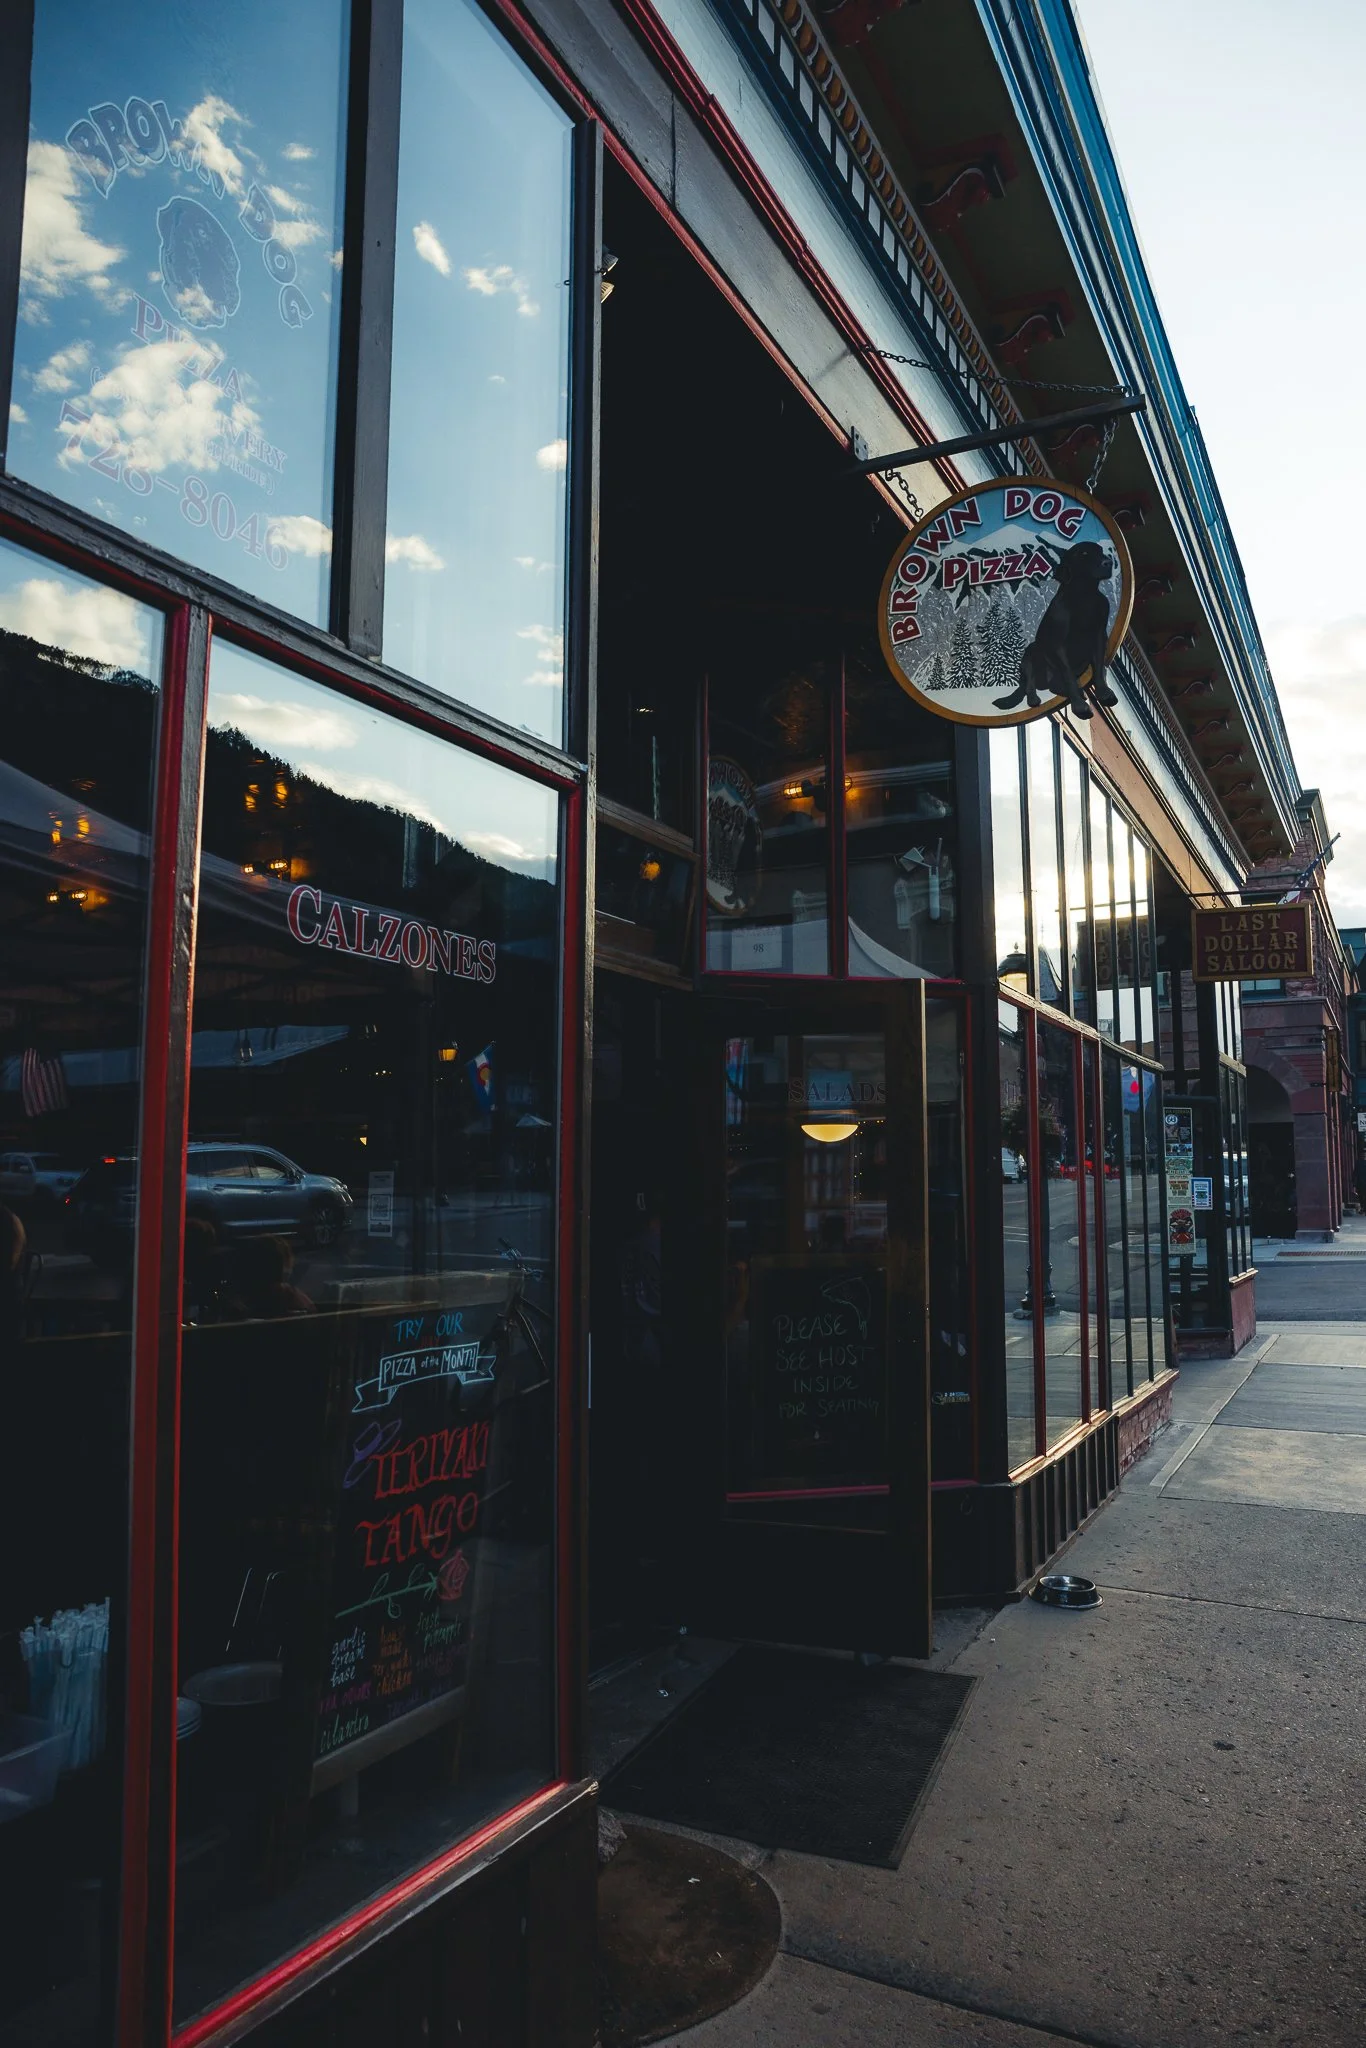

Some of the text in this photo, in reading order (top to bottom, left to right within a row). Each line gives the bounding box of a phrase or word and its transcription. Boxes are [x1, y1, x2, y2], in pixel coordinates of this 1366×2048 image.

[238, 183, 314, 329] DOG
[890, 487, 1087, 645] BROWN DOG
[942, 551, 1053, 590] PIZZA
[287, 884, 497, 984] CALZONES
[1219, 912, 1281, 932] LAST
[1203, 931, 1298, 953] DOLLAR
[1207, 952, 1296, 973] SALOON
[393, 1316, 425, 1343] TRY
[436, 1311, 464, 1337] OUR
[772, 1313, 848, 1344] PLEASE
[383, 1356, 417, 1384] PIZZA
[440, 1347, 477, 1374] MONTH
[775, 1343, 876, 1372] SEE HOST
[793, 1375, 860, 1394] INSIDE
[779, 1400, 808, 1420] FOR
